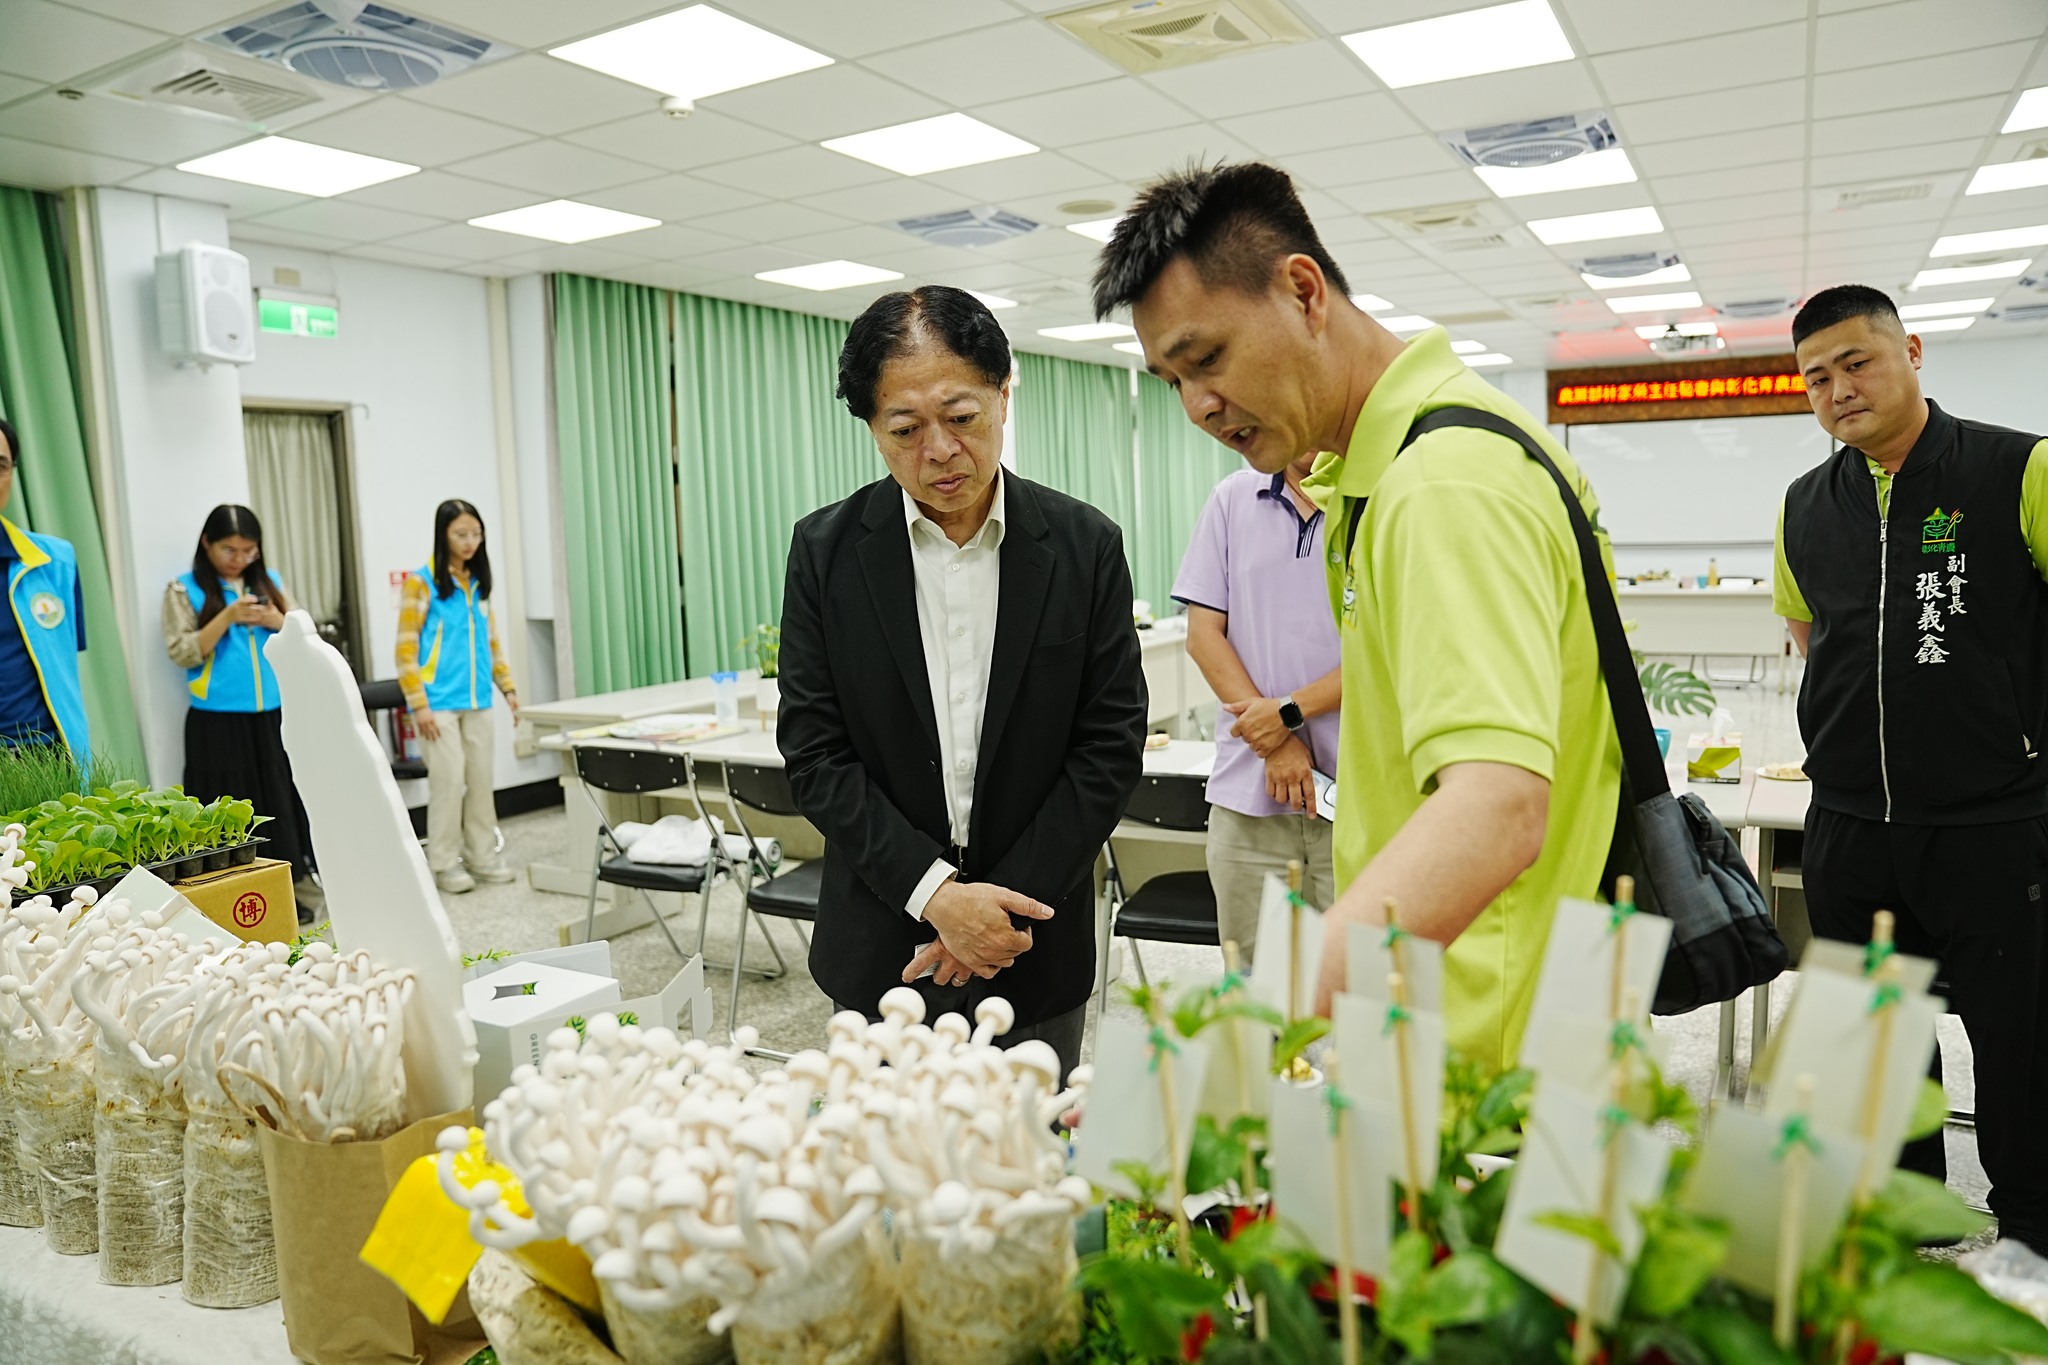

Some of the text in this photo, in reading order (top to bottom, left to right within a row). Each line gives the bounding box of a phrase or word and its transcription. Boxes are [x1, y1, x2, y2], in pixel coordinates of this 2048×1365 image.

[1946, 553, 1968, 615] 副會長
[1914, 571, 1950, 664] 張義鑫
[530, 1033, 541, 1067] GREEN
